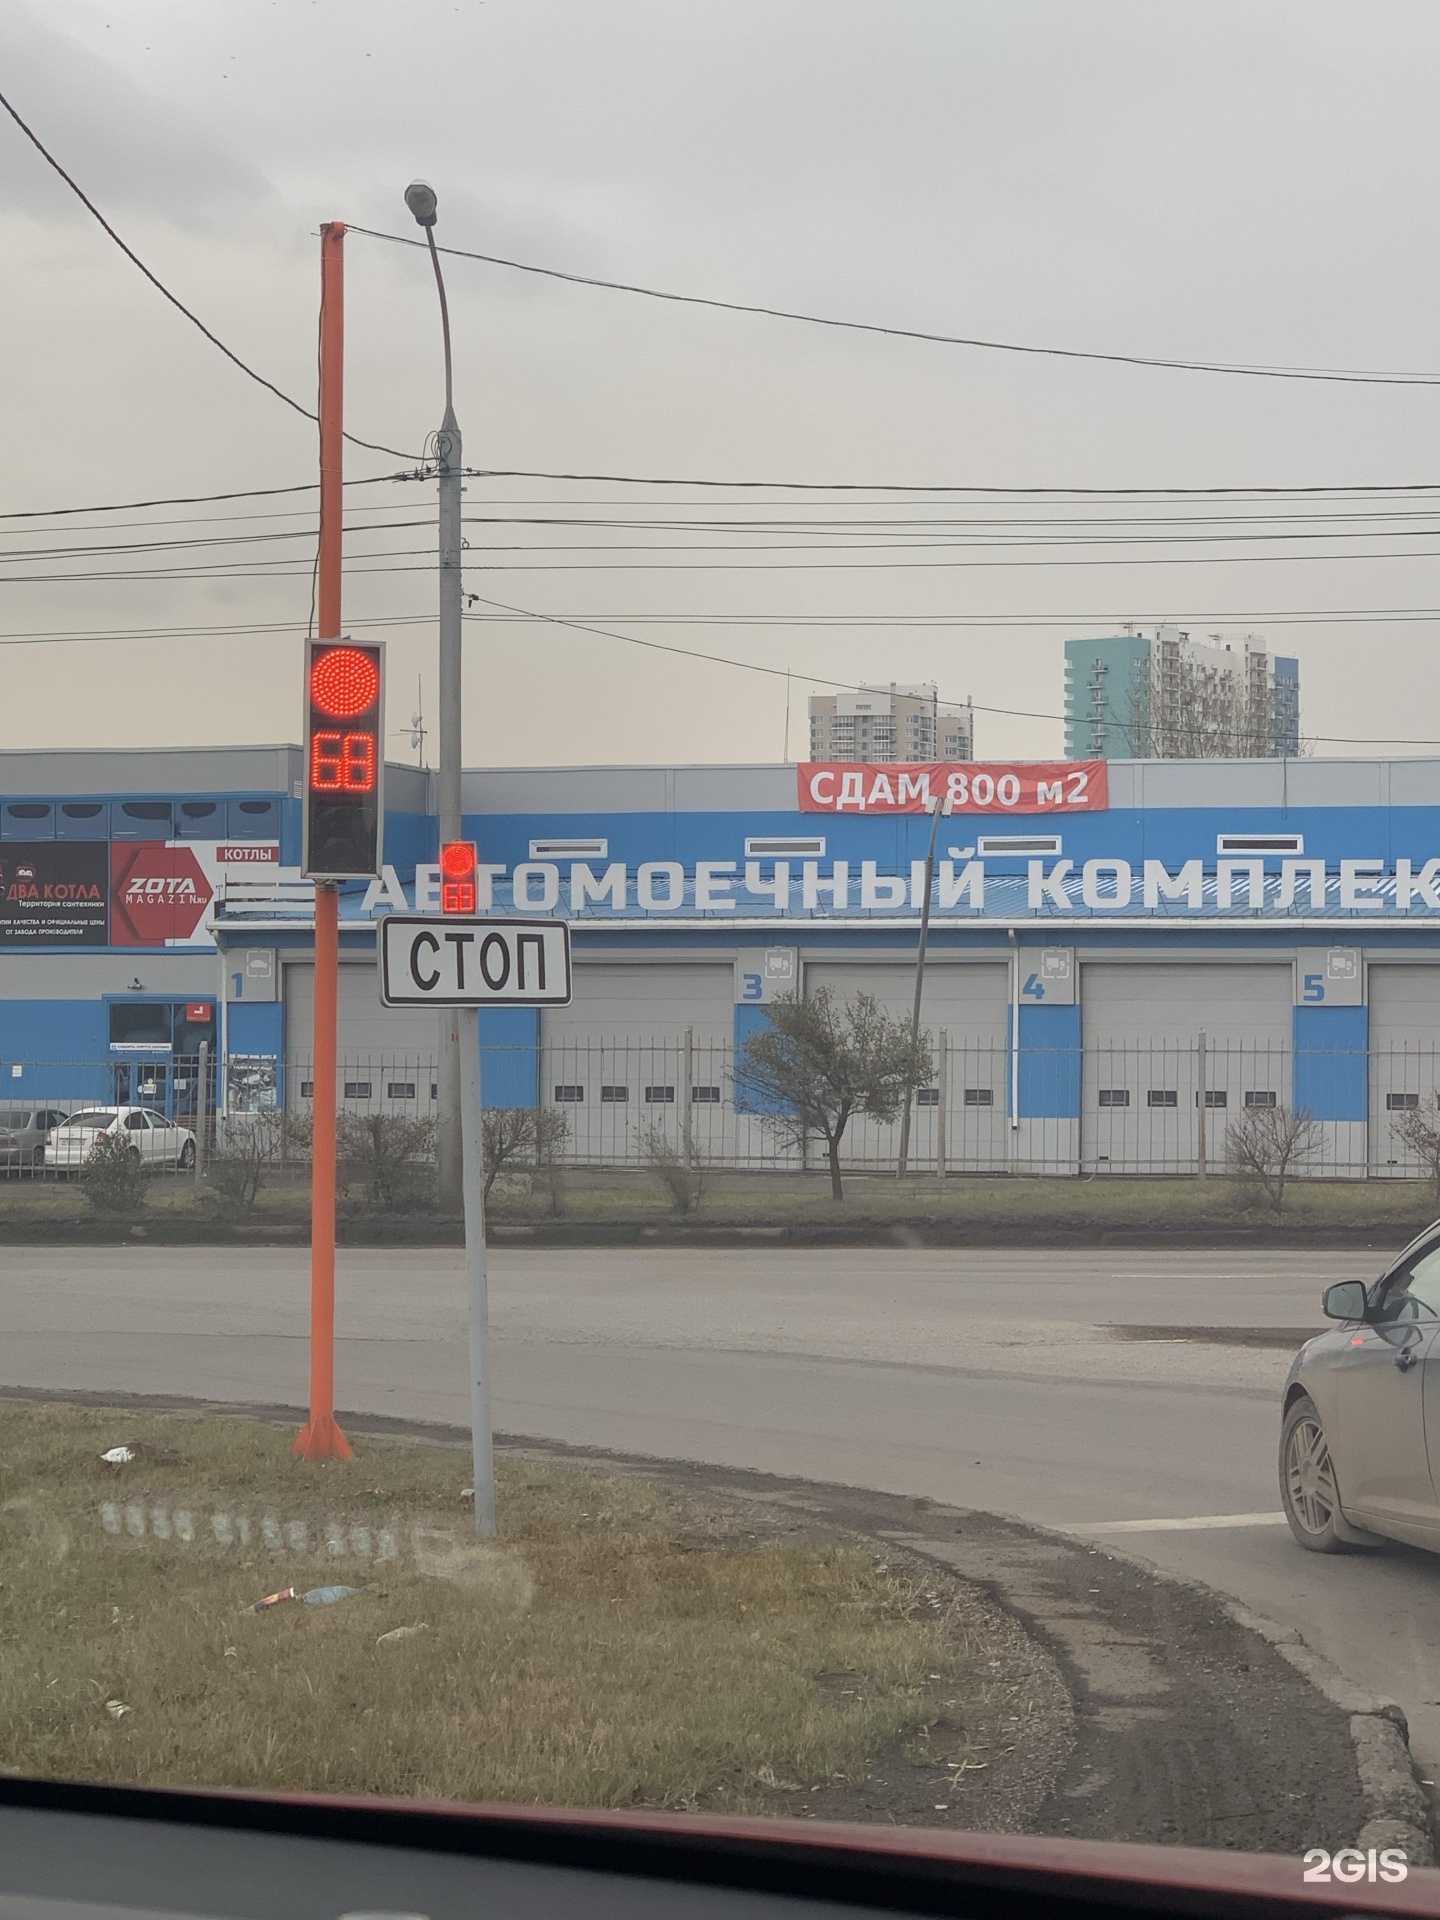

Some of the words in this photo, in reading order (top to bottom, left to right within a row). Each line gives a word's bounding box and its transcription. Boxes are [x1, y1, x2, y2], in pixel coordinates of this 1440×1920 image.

[312, 732, 374, 791] 68
[809, 771, 930, 811] СДАМ
[947, 773, 1021, 806] 800
[1036, 771, 1089, 806] м2
[223, 848, 272, 861] КОТЛЫ
[7, 882, 39, 901] ДВА
[43, 882, 102, 899] КОТЛА
[126, 878, 196, 894] ZOTA
[1027, 858, 1440, 910] КОМПЛЕК
[410, 931, 546, 991] СТОП
[231, 972, 243, 998] 1
[743, 974, 762, 1000] 3
[1022, 973, 1046, 1000] 4
[1303, 974, 1326, 1002] 5
